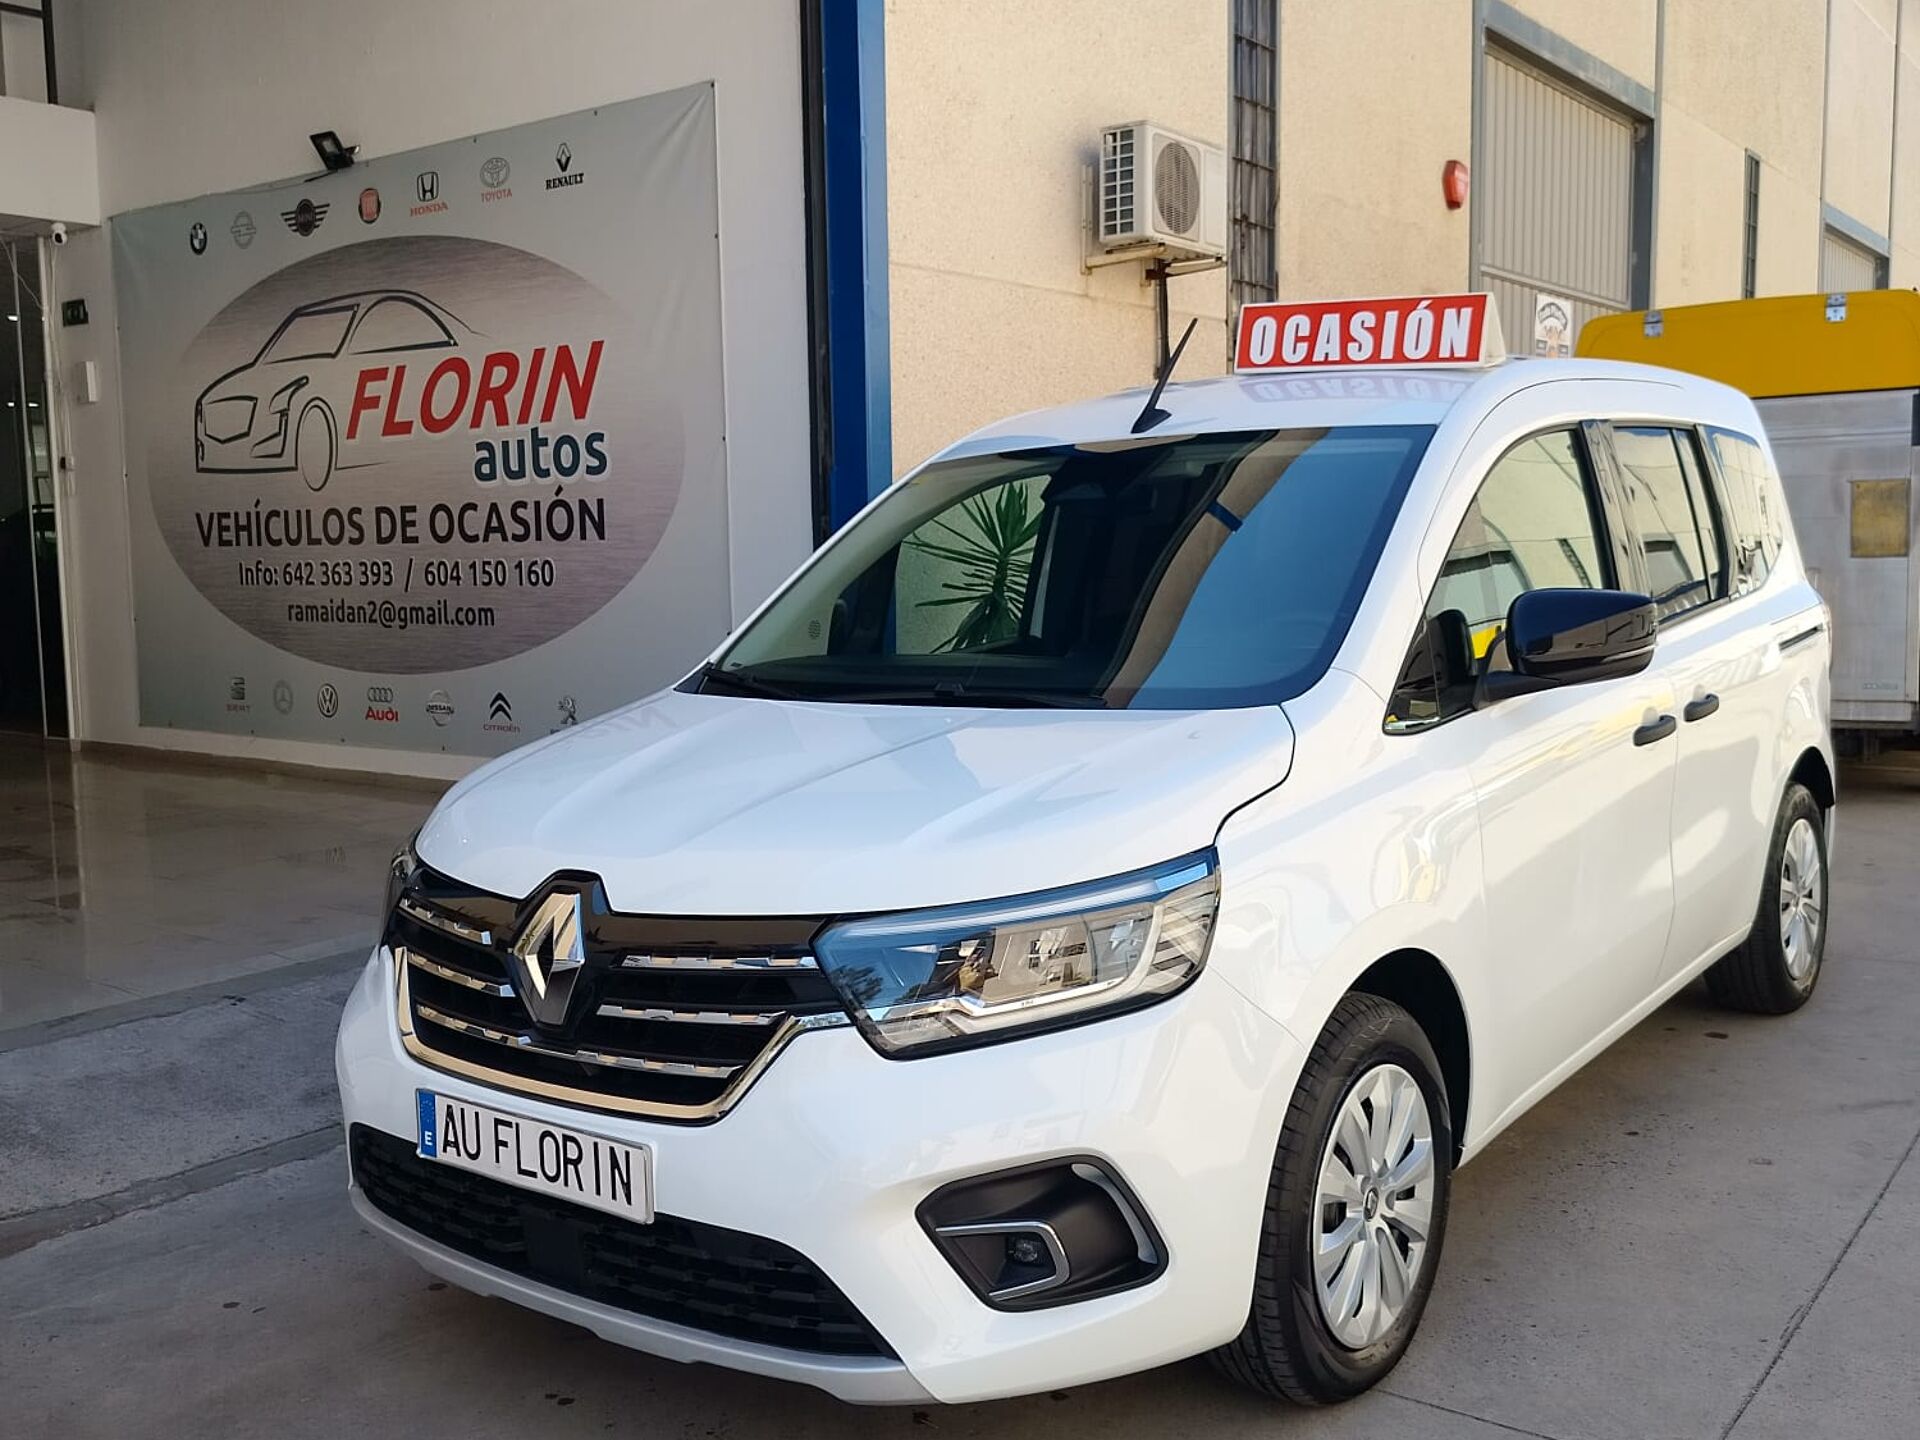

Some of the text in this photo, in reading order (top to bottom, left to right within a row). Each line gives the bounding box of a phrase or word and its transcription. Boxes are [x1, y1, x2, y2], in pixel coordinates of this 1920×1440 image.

[480, 188, 513, 203] TOYOTA
[545, 173, 584, 190] RENAULT
[409, 202, 449, 217] HONDA
[1249, 300, 1472, 364] OCASIÓN
[346, 340, 604, 440] FLORIN
[474, 427, 608, 482] autos
[196, 486, 607, 547] VEHÍCULOS DE OCASIÓN
[239, 562, 280, 586] Info:
[283, 562, 317, 586] 642
[320, 561, 354, 586] 363
[359, 561, 394, 586] 393
[425, 560, 462, 586] 604
[469, 560, 507, 586] 150
[515, 559, 554, 586] 160
[288, 599, 496, 629] ramaidan2@gmail.com
[365, 707, 399, 722] Audi
[424, 1130, 433, 1146] E
[442, 1104, 632, 1206] AU FLORIN
